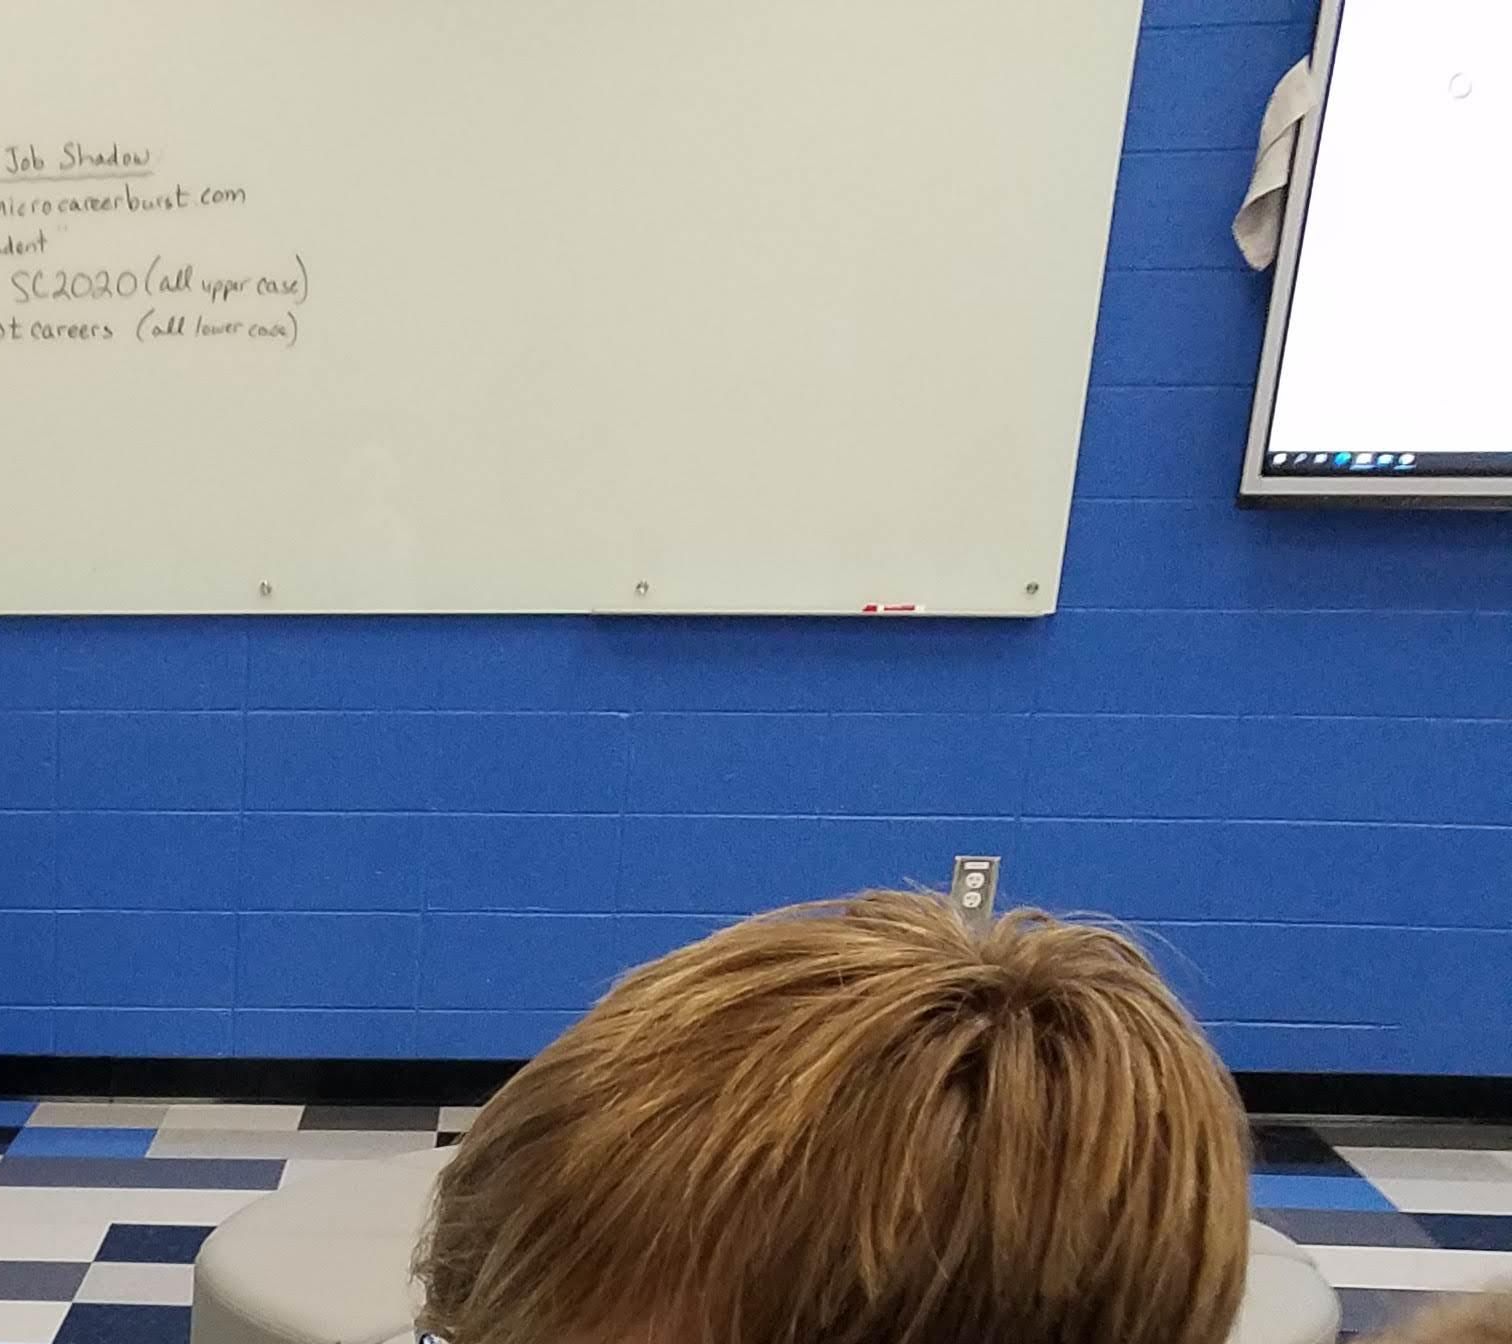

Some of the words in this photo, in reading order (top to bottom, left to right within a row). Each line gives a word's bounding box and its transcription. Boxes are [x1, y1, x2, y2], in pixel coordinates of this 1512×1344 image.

[5, 143, 44, 174] Job
[59, 142, 150, 170] Shadow
[201, 276, 253, 304] upper
